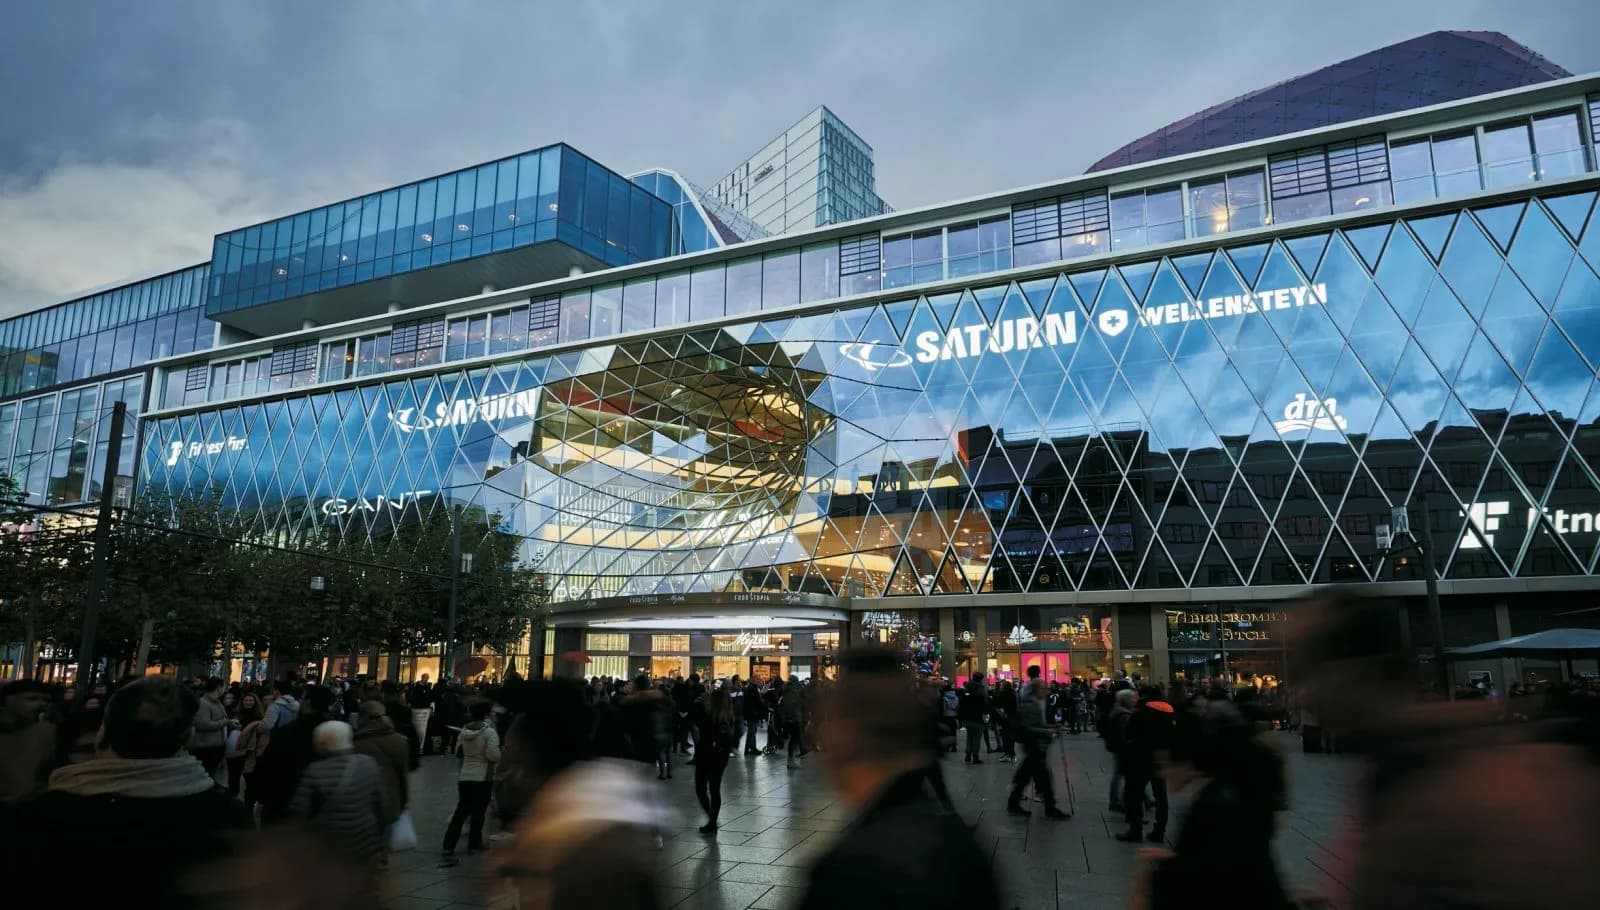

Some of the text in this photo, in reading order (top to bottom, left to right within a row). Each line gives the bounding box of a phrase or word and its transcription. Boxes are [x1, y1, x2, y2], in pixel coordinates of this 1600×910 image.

[1140, 283, 1328, 327] WELLENSTEYN
[915, 311, 1077, 364] SATURN
[435, 389, 537, 428] SATURN
[1284, 393, 1337, 422] dm
[322, 490, 432, 516] GANT
